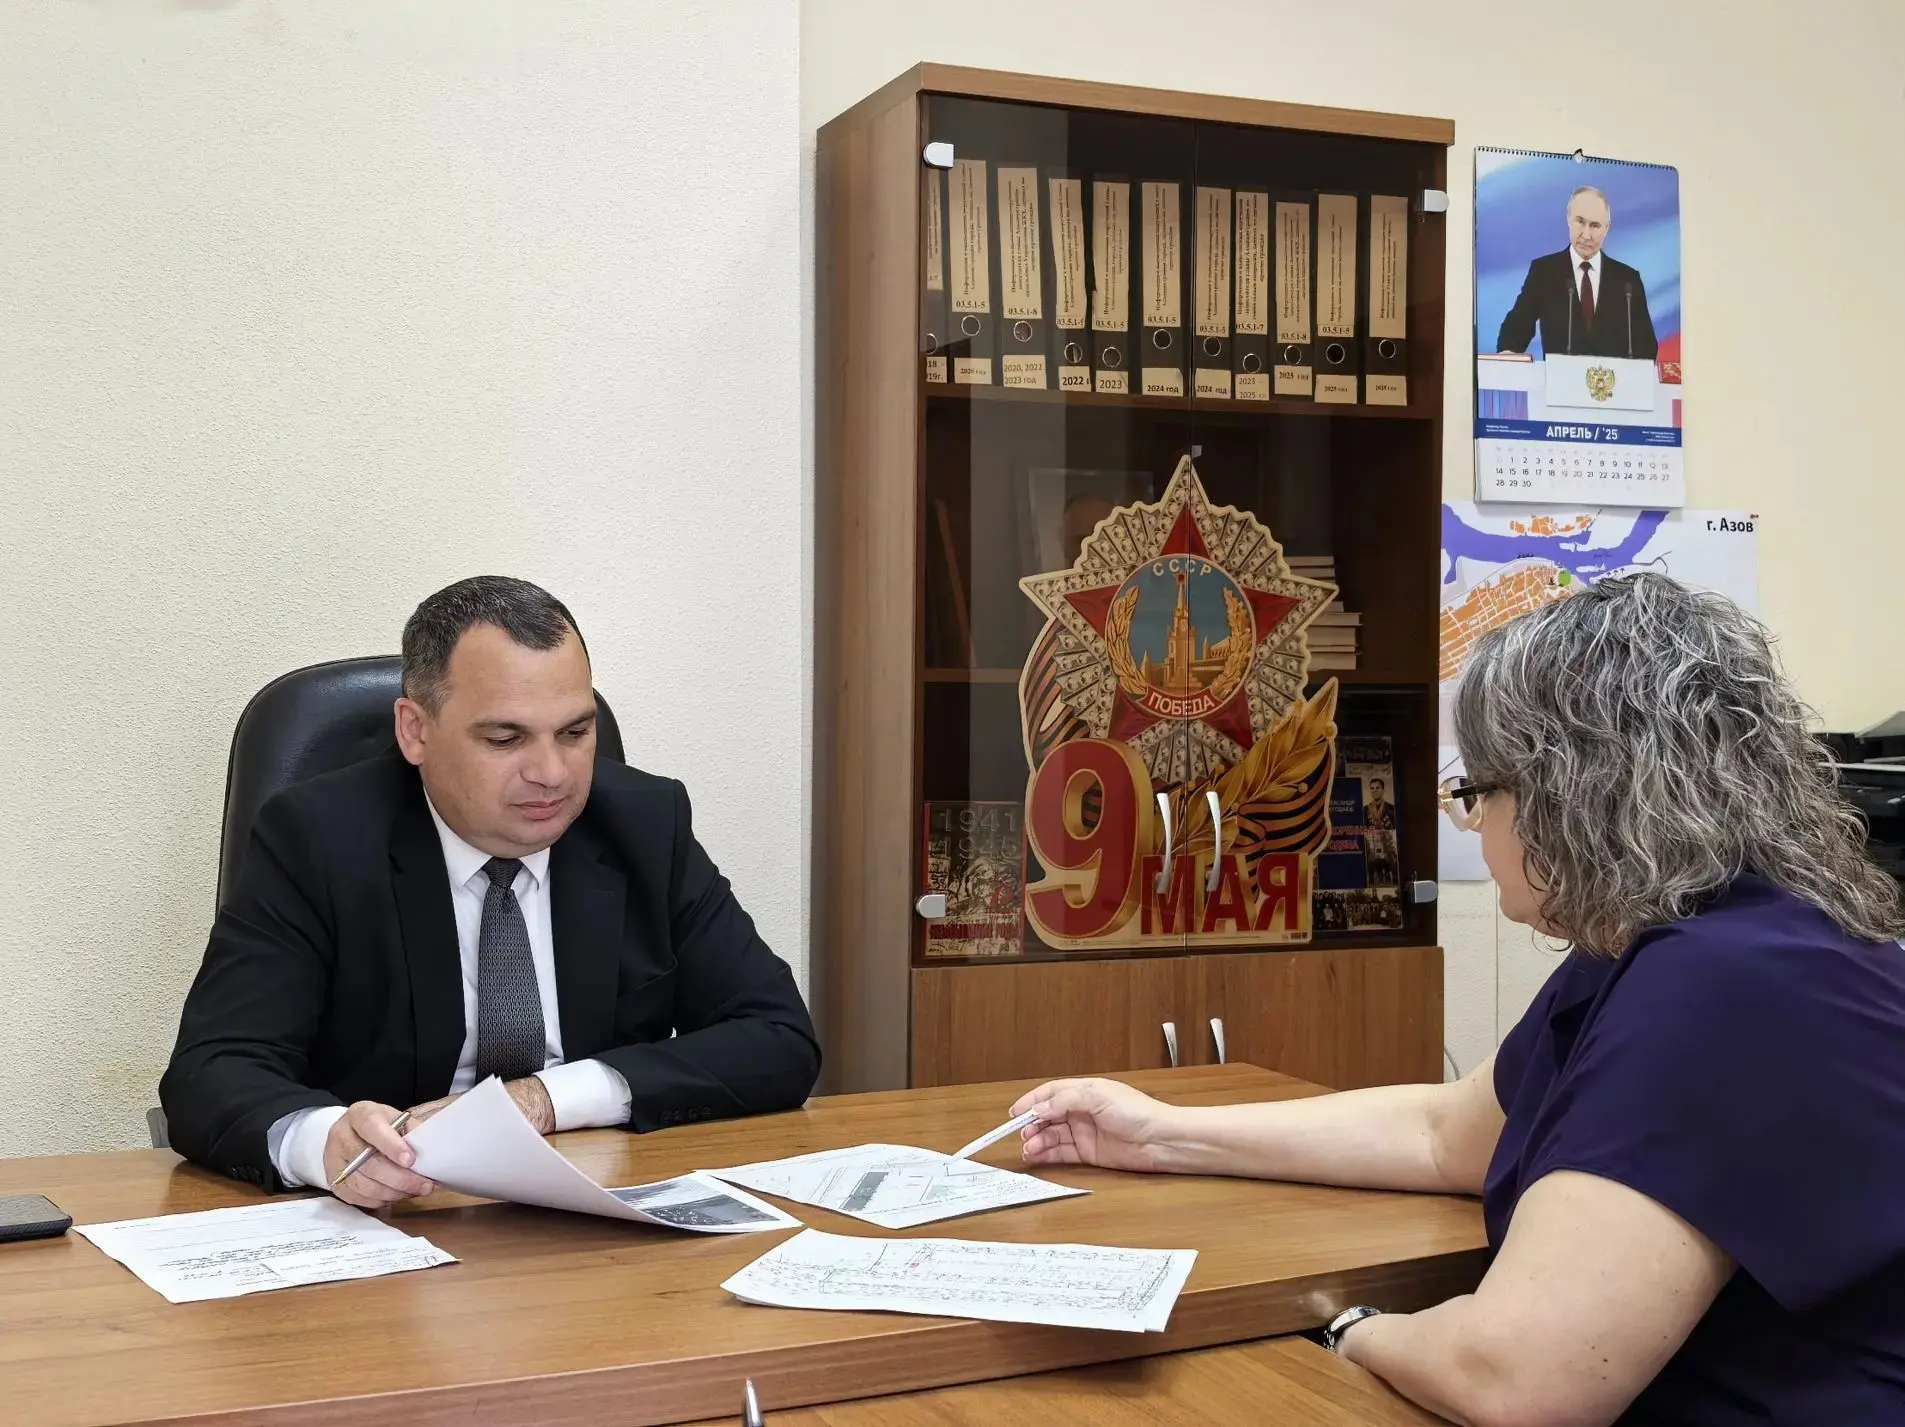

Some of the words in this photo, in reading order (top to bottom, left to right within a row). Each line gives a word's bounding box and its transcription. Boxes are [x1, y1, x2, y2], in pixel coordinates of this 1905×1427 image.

[956, 300, 986, 309] 03.5.1-5
[1008, 308, 1038, 316] 03.5.1-8
[1004, 376, 1022, 385] 2023
[1023, 377, 1037, 385] год
[1062, 376, 1084, 386] 2022
[1099, 380, 1122, 389] 2023
[1239, 377, 1256, 385] 2023
[1147, 384, 1165, 393] 2024
[1196, 385, 1212, 393] 2024
[1239, 391, 1256, 399] 2025
[1546, 425, 1592, 439] АПРЕЛЬ
[1706, 520, 1716, 531] г.
[1719, 517, 1754, 532] Азов
[1152, 558, 1212, 577] СССР
[1148, 692, 1216, 717] ПОБЕДА
[940, 808, 1017, 832] 1941
[1028, 738, 1150, 938] 9
[1140, 853, 1301, 936] МАЯ
